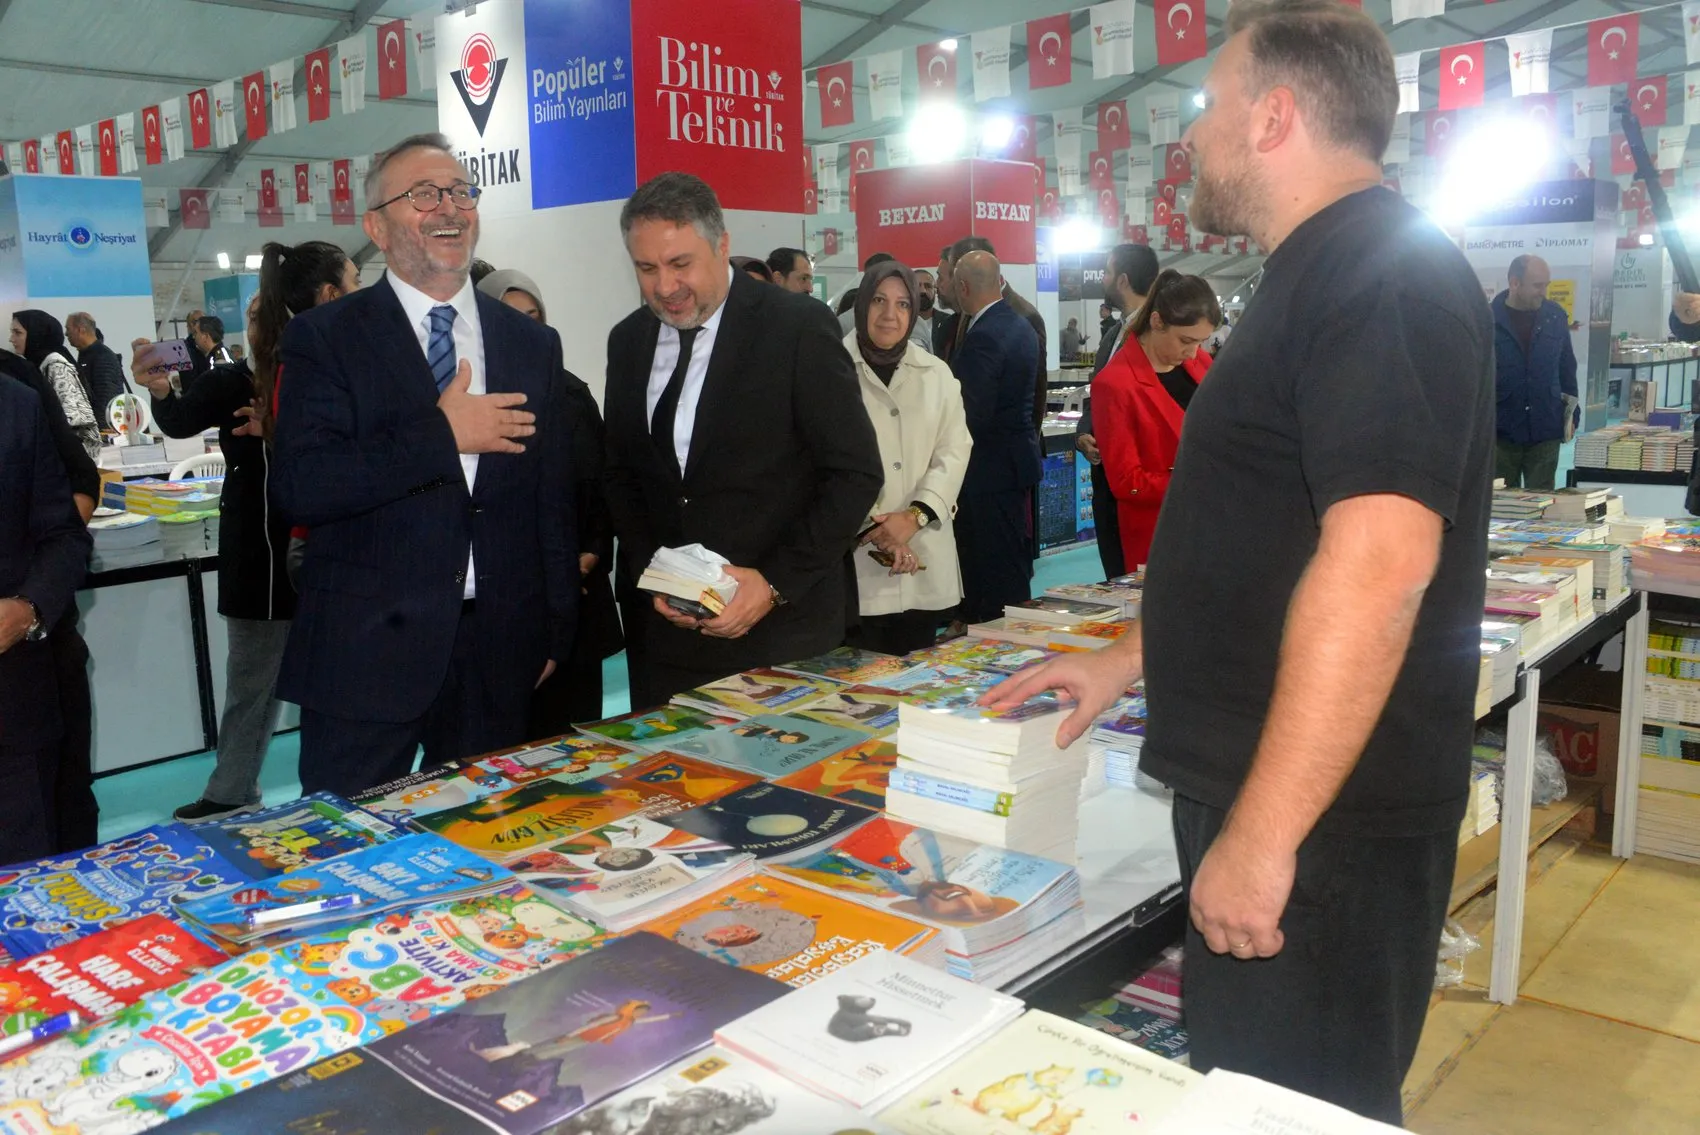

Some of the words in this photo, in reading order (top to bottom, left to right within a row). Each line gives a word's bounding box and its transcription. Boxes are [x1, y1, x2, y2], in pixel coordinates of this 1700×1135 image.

[532, 57, 607, 98] Popüler
[657, 36, 761, 99] Bilim
[534, 100, 566, 124] Bilim
[568, 88, 627, 121] Yayınları
[656, 89, 786, 152] Teknik
[714, 96, 735, 113] ve
[457, 148, 521, 185] ÜBİTAK
[878, 203, 946, 227] BEYAN
[975, 200, 1031, 222] BEYAN
[28, 231, 68, 245] Hayrât
[95, 231, 137, 245] Neşriyat
[78, 953, 145, 990] HARF
[398, 937, 476, 983] AKTİVİTE
[17, 954, 127, 1017] ÇALIŞMAS
[216, 966, 324, 1039] DİNOZOR
[166, 1007, 263, 1076] KİTABI
[180, 982, 312, 1073] BOYAMA
